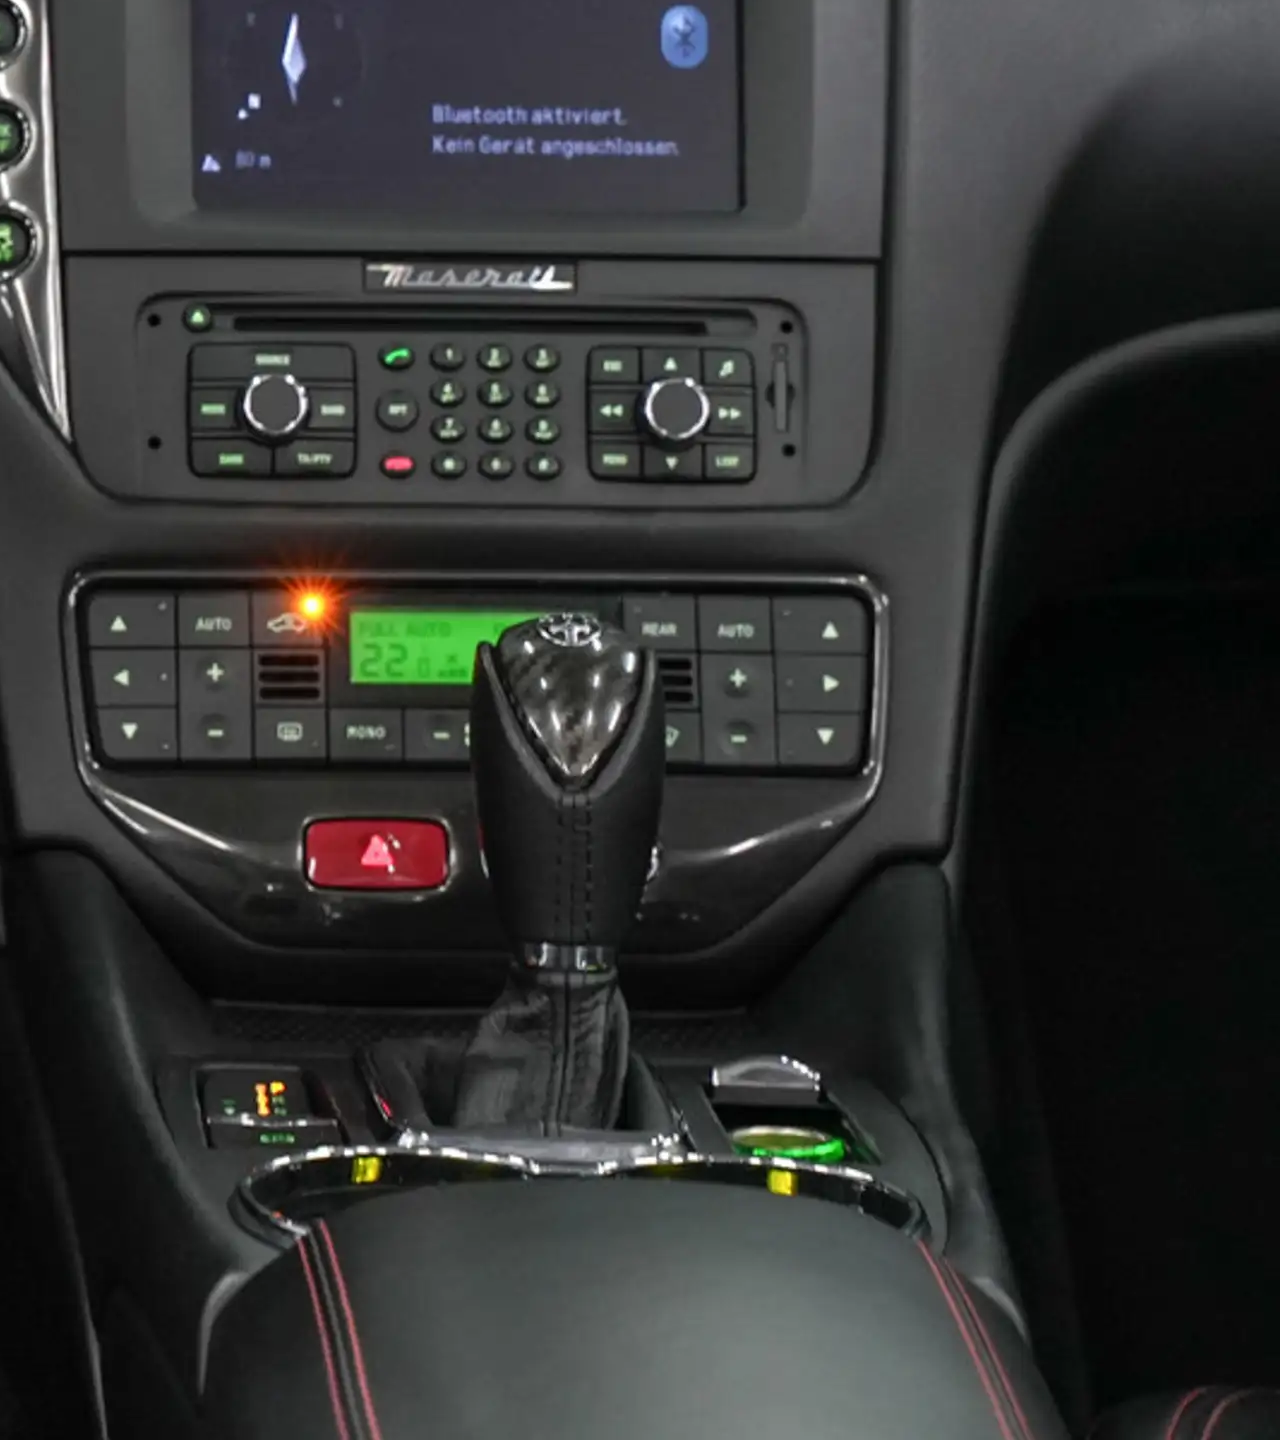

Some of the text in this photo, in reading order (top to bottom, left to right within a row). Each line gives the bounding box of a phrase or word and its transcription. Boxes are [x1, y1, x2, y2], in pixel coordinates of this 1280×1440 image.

[432, 104, 528, 125] Bluetooth
[432, 135, 475, 154] Kein
[479, 135, 536, 155] Gerät
[366, 264, 573, 290] Maserati
[195, 616, 232, 631] AUTO
[406, 621, 452, 638] AUTO
[642, 623, 677, 637] REAR
[717, 624, 754, 638] AUTO
[360, 643, 408, 677] 22
[346, 725, 386, 739] MONO
